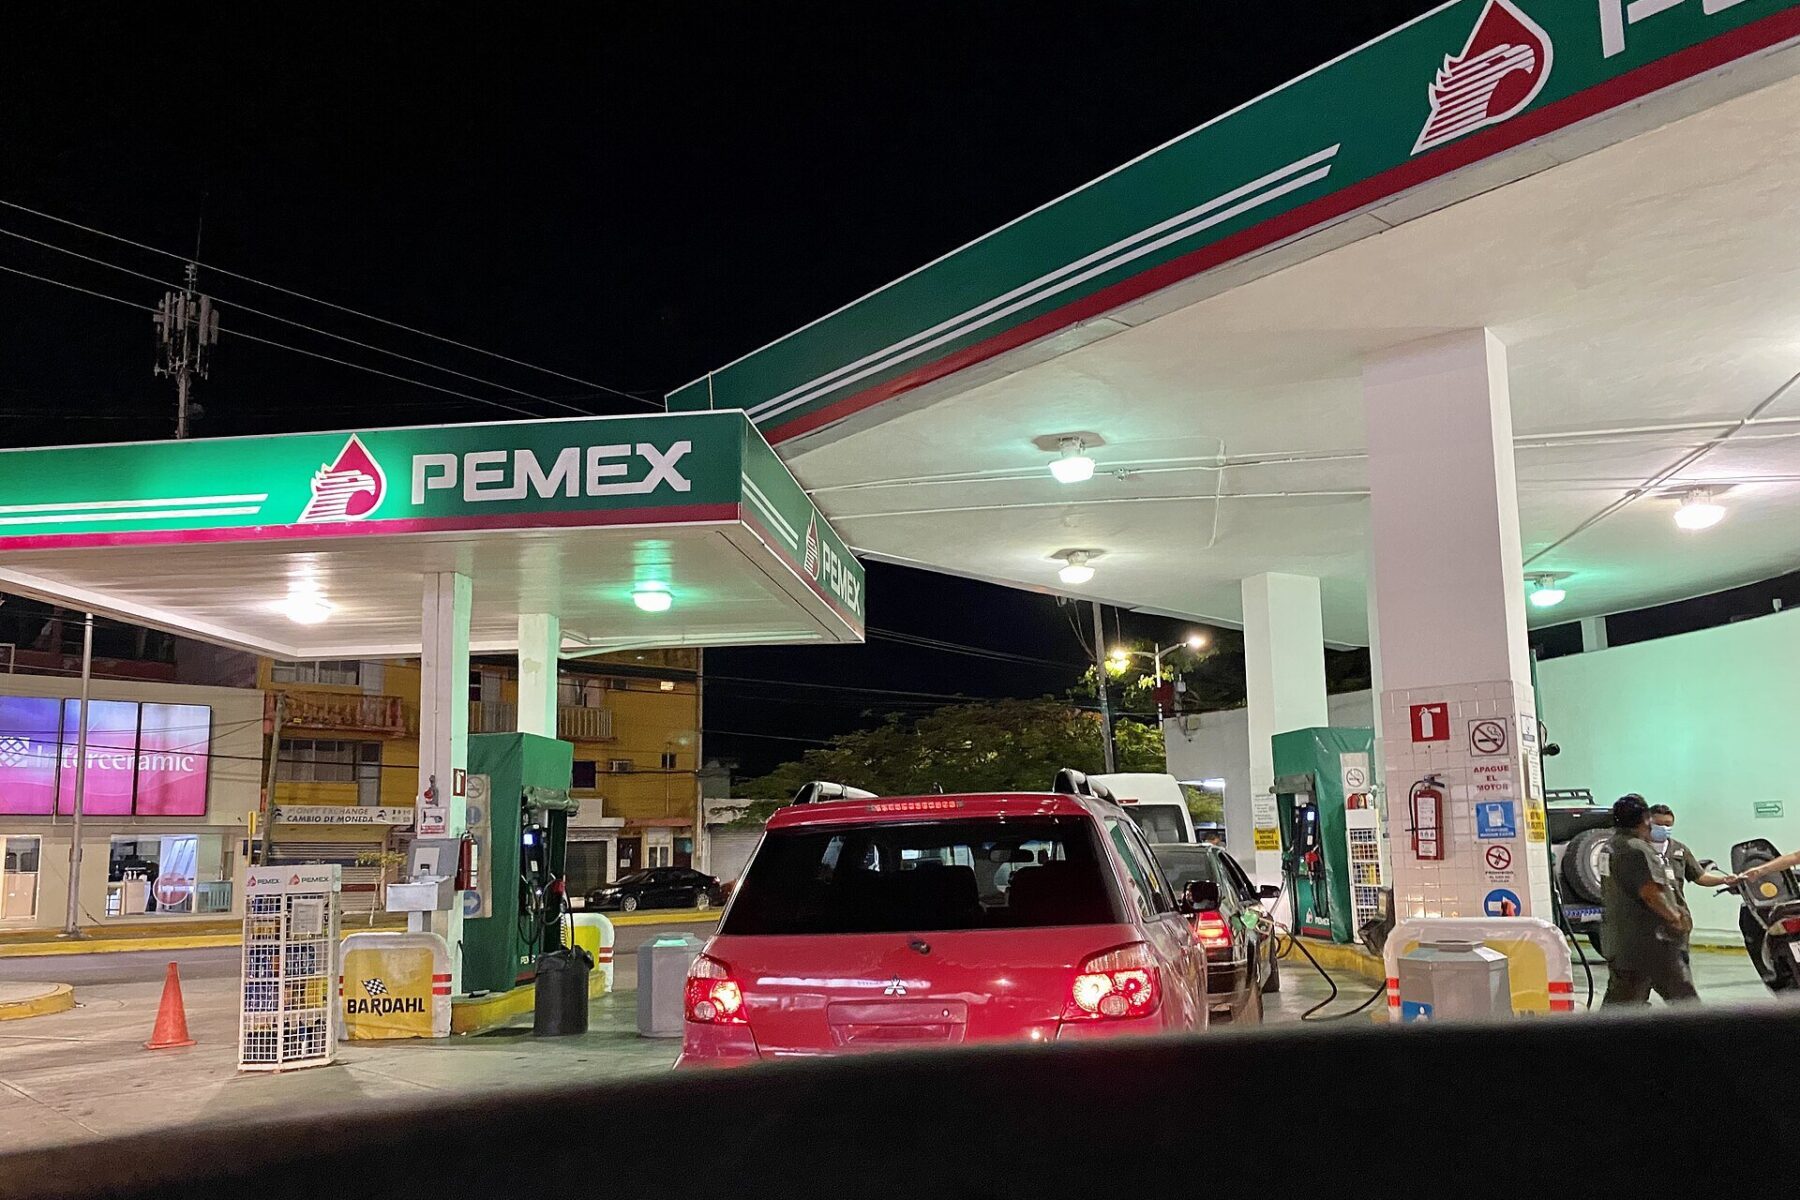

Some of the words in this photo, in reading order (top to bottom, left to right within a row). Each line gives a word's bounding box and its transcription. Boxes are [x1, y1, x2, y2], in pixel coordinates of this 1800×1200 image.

[411, 441, 692, 505] PEMEX
[822, 540, 860, 616] PEMEX
[1473, 764, 1510, 774] APAGUE
[1476, 783, 1509, 791] MOTOR
[286, 815, 321, 823] CAMBIO
[347, 997, 426, 1017] BARDAHL
